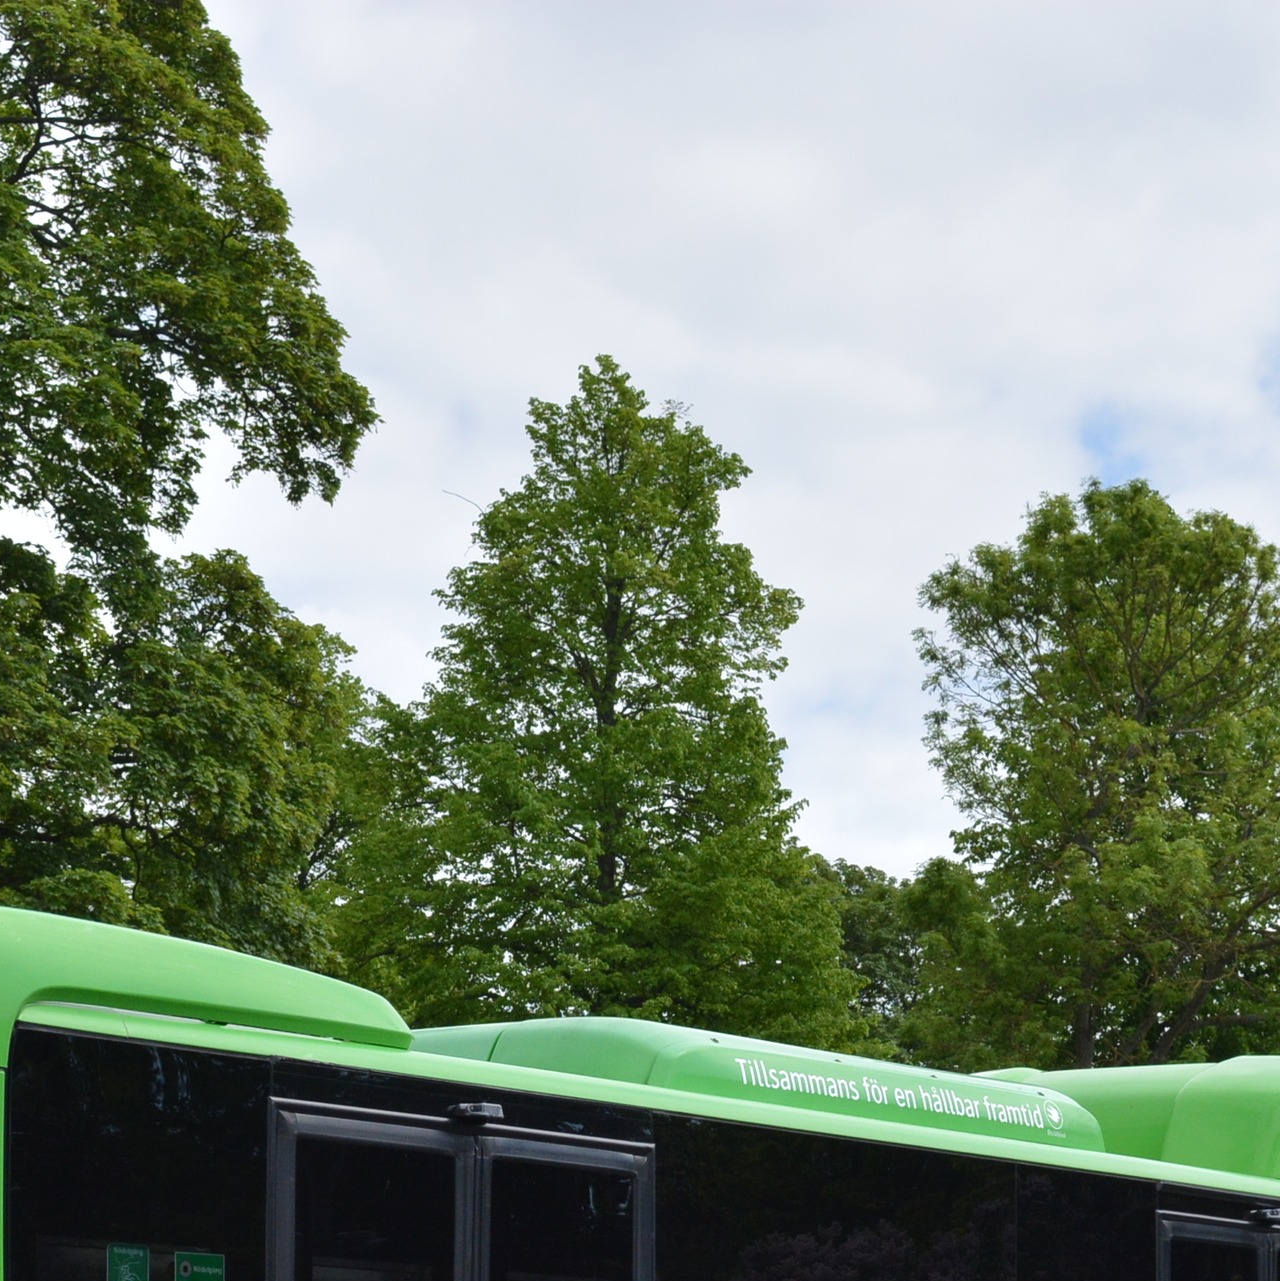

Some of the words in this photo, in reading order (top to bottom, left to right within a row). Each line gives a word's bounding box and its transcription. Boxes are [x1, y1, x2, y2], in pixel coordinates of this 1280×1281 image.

[734, 1057, 860, 1101] Tillsammans
[863, 1075, 889, 1106] för
[894, 1086, 919, 1111] en
[919, 1084, 981, 1120] hållbar
[983, 1096, 1045, 1129] framtid
